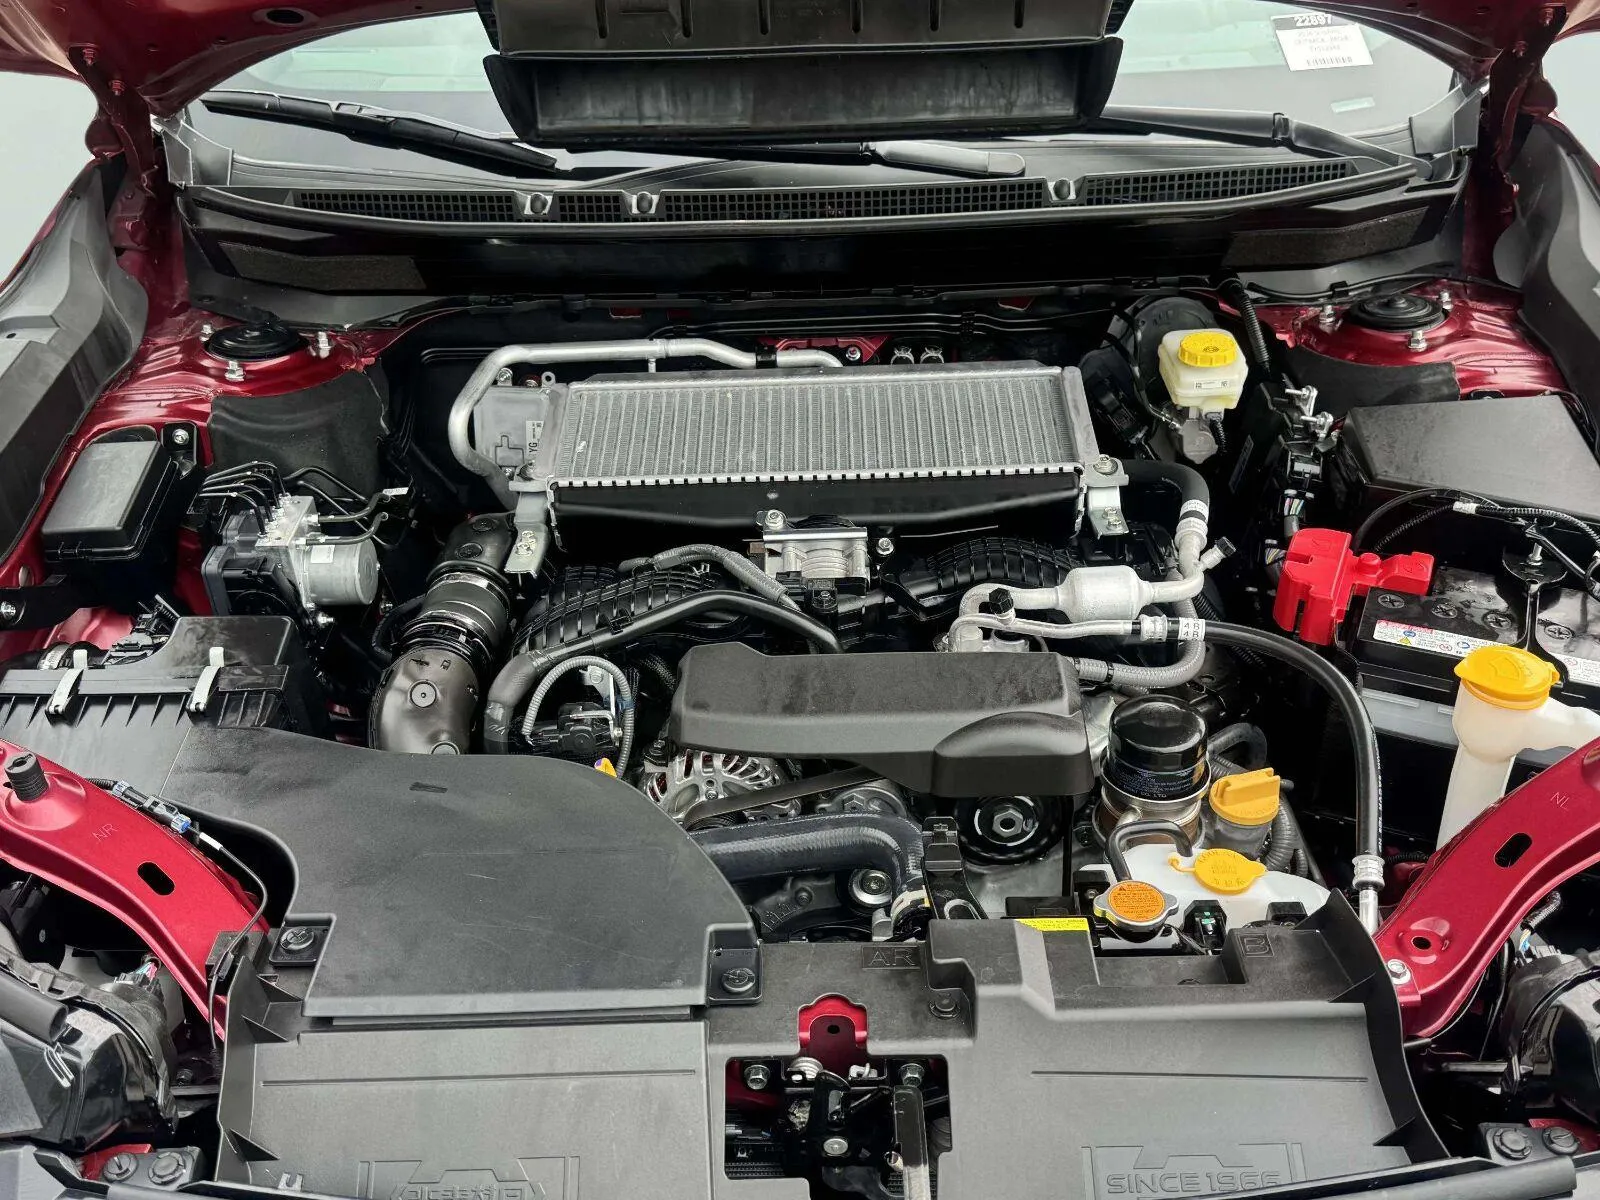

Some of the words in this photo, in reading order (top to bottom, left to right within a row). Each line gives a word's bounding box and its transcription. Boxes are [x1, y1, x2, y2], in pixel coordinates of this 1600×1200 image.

[1294, 13, 1332, 26] 22897
[868, 948, 917, 966] AR
[1106, 1172, 1201, 1194] SINCE
[1206, 1171, 1281, 1192] 1966
